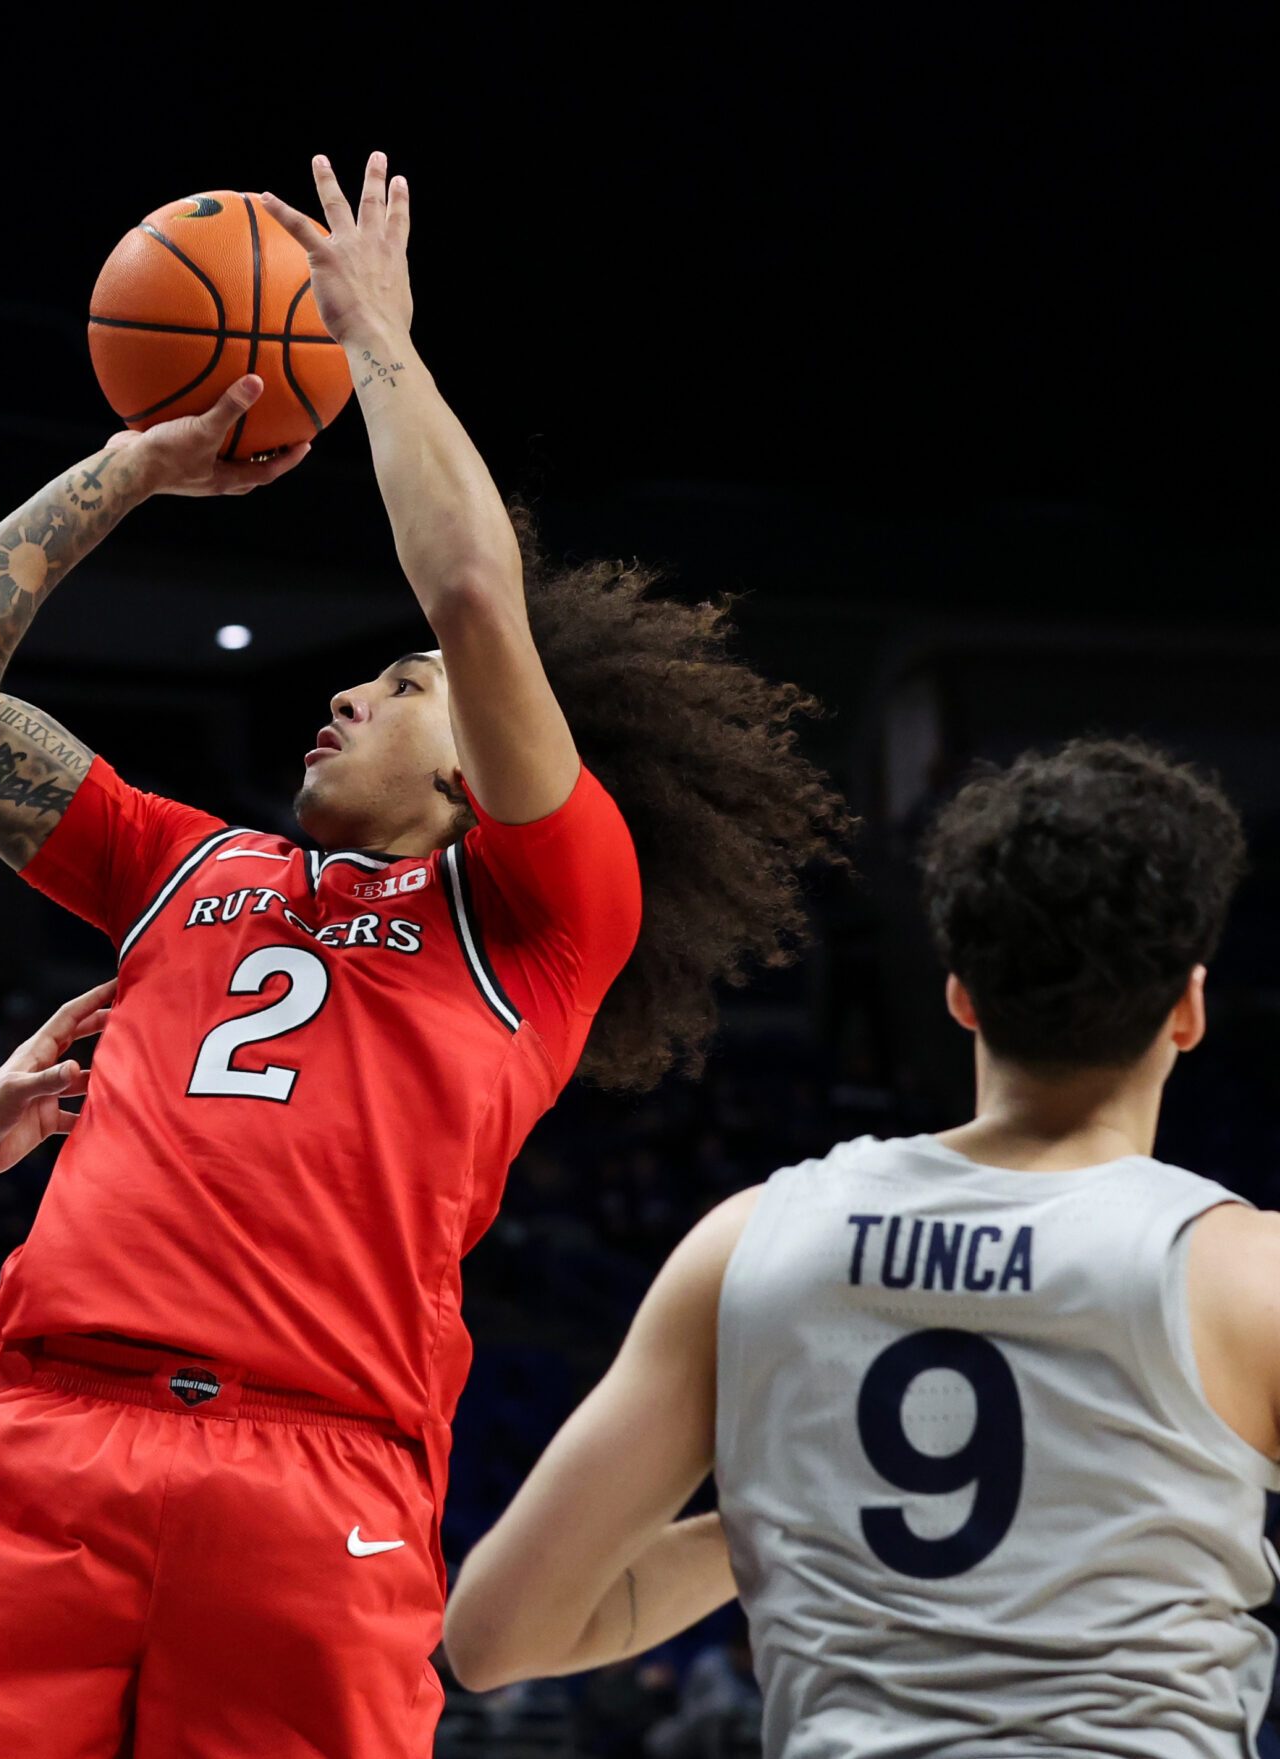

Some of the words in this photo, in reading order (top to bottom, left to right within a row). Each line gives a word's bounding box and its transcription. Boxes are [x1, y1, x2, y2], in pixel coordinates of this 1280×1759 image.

[185, 945, 331, 1104] 2
[848, 1215, 1034, 1291] TUNCA
[857, 1327, 1026, 1580] 9
